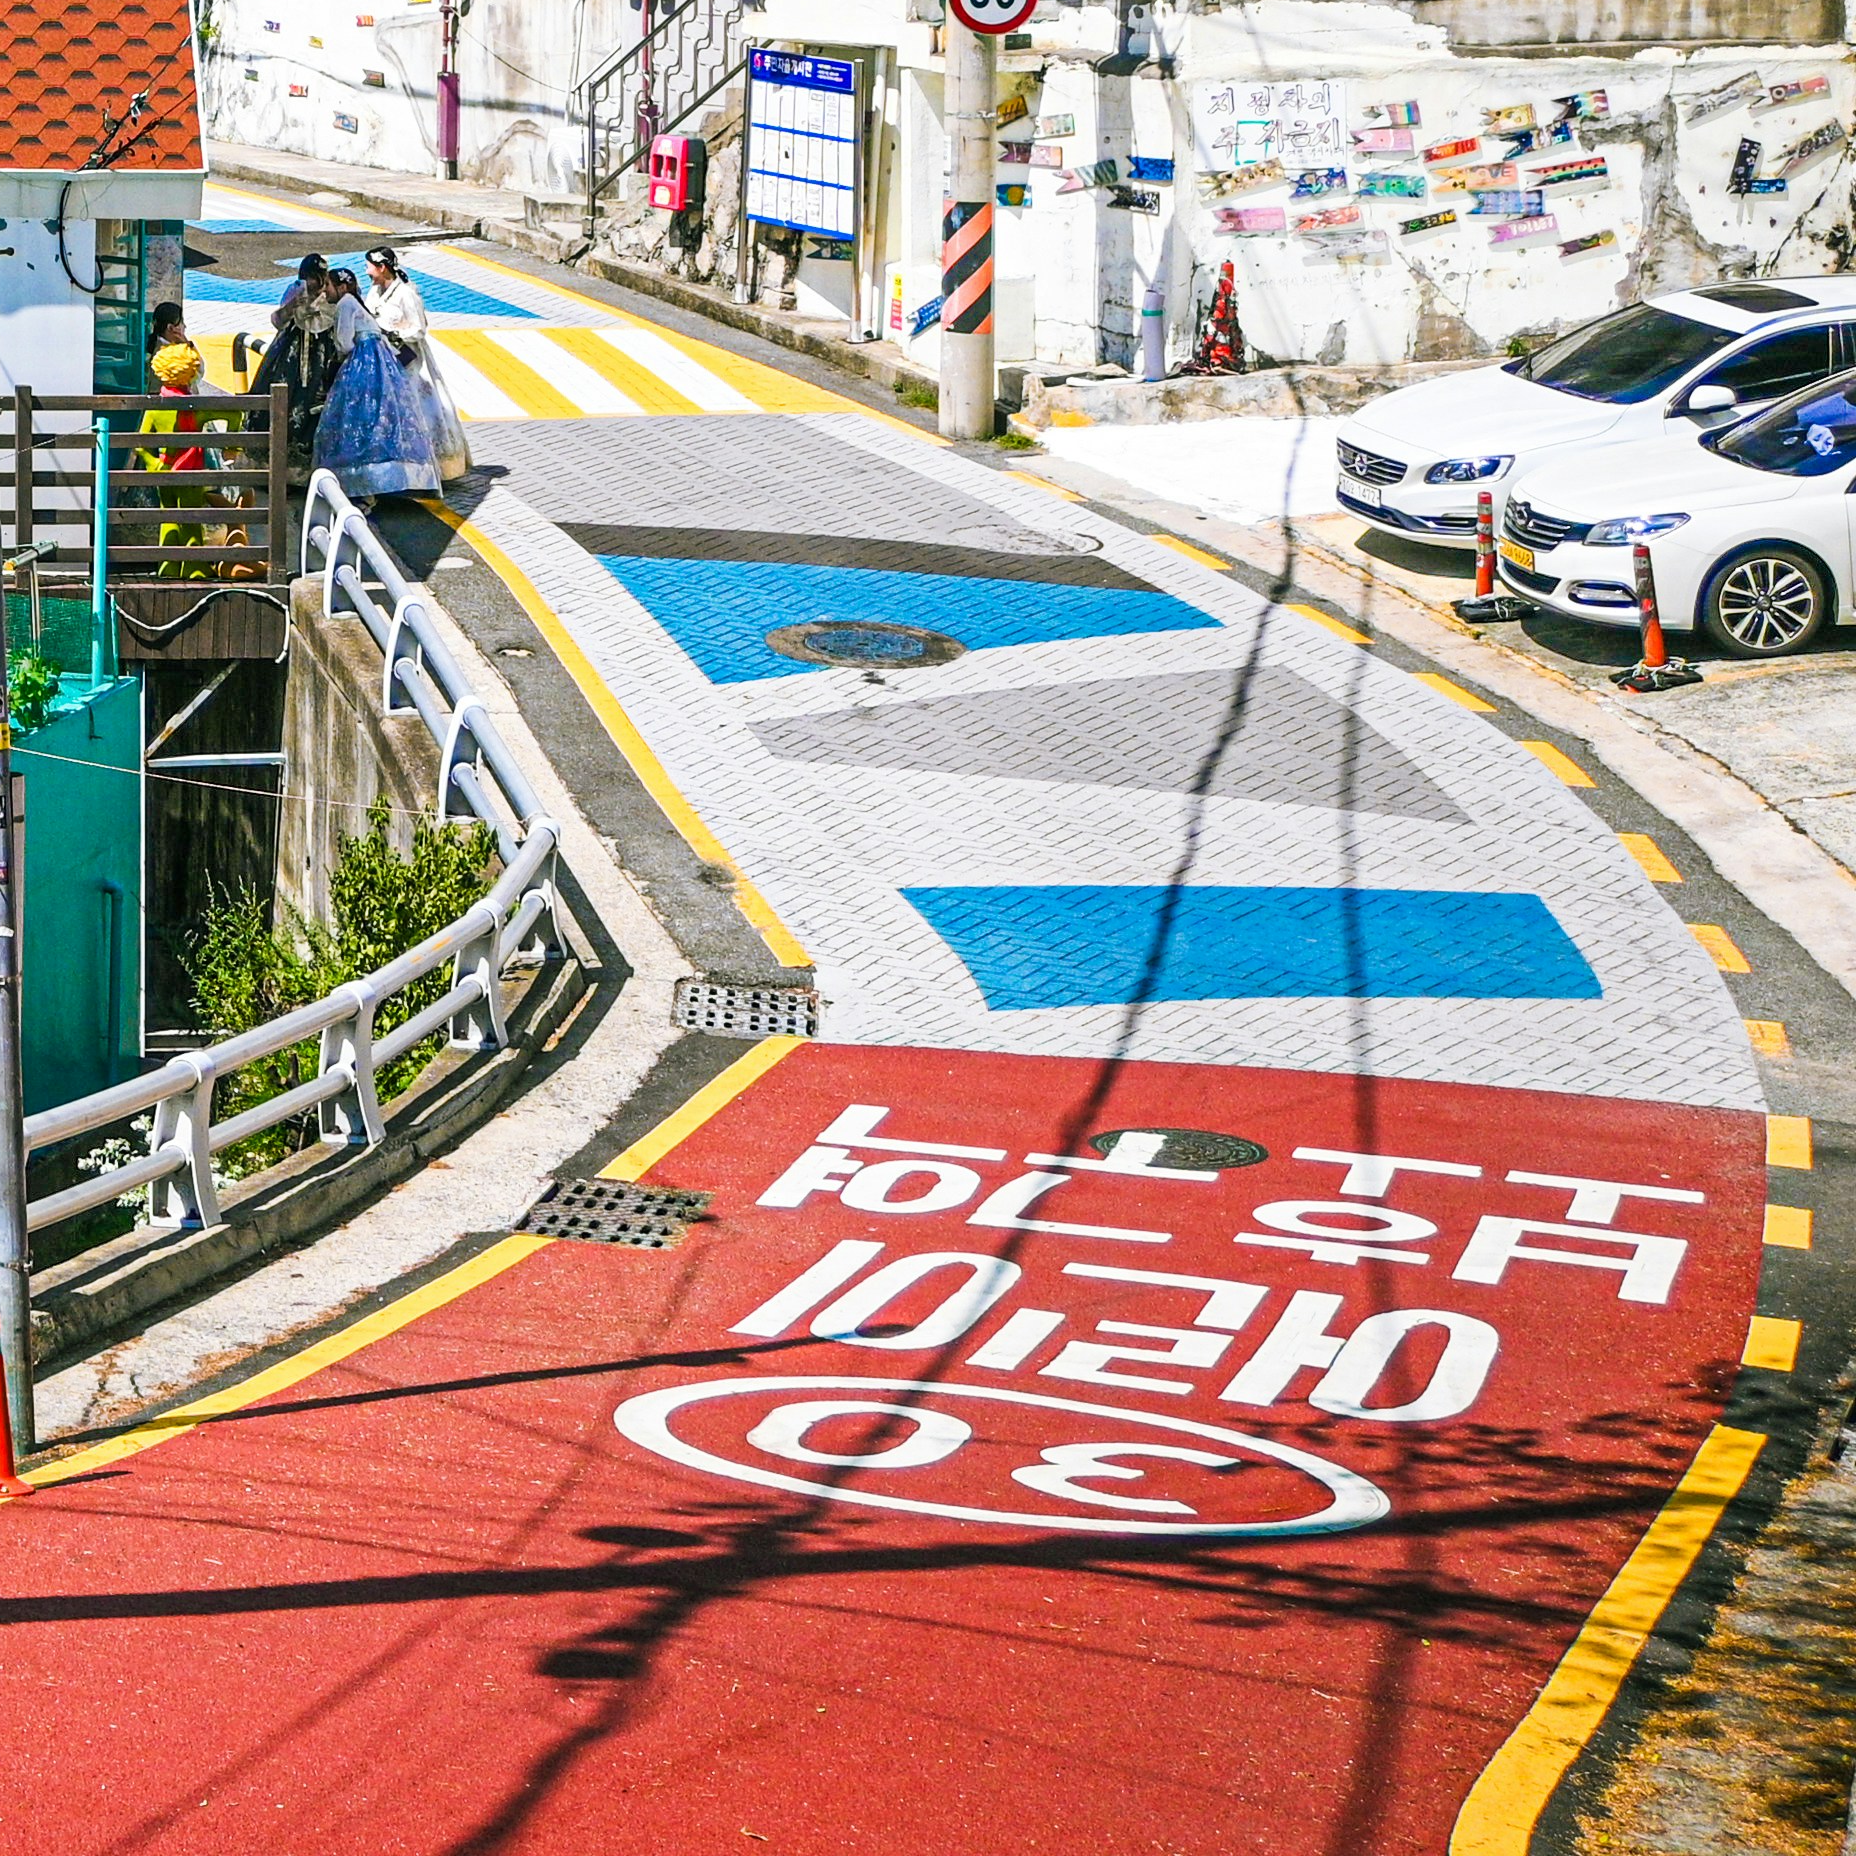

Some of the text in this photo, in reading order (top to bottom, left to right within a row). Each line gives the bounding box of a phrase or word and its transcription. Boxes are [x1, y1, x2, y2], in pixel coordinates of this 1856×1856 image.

[756, 1104, 1704, 1304] 보호구역
[727, 1240, 1499, 1421] 어린이
[747, 1401, 1239, 1515] 30
